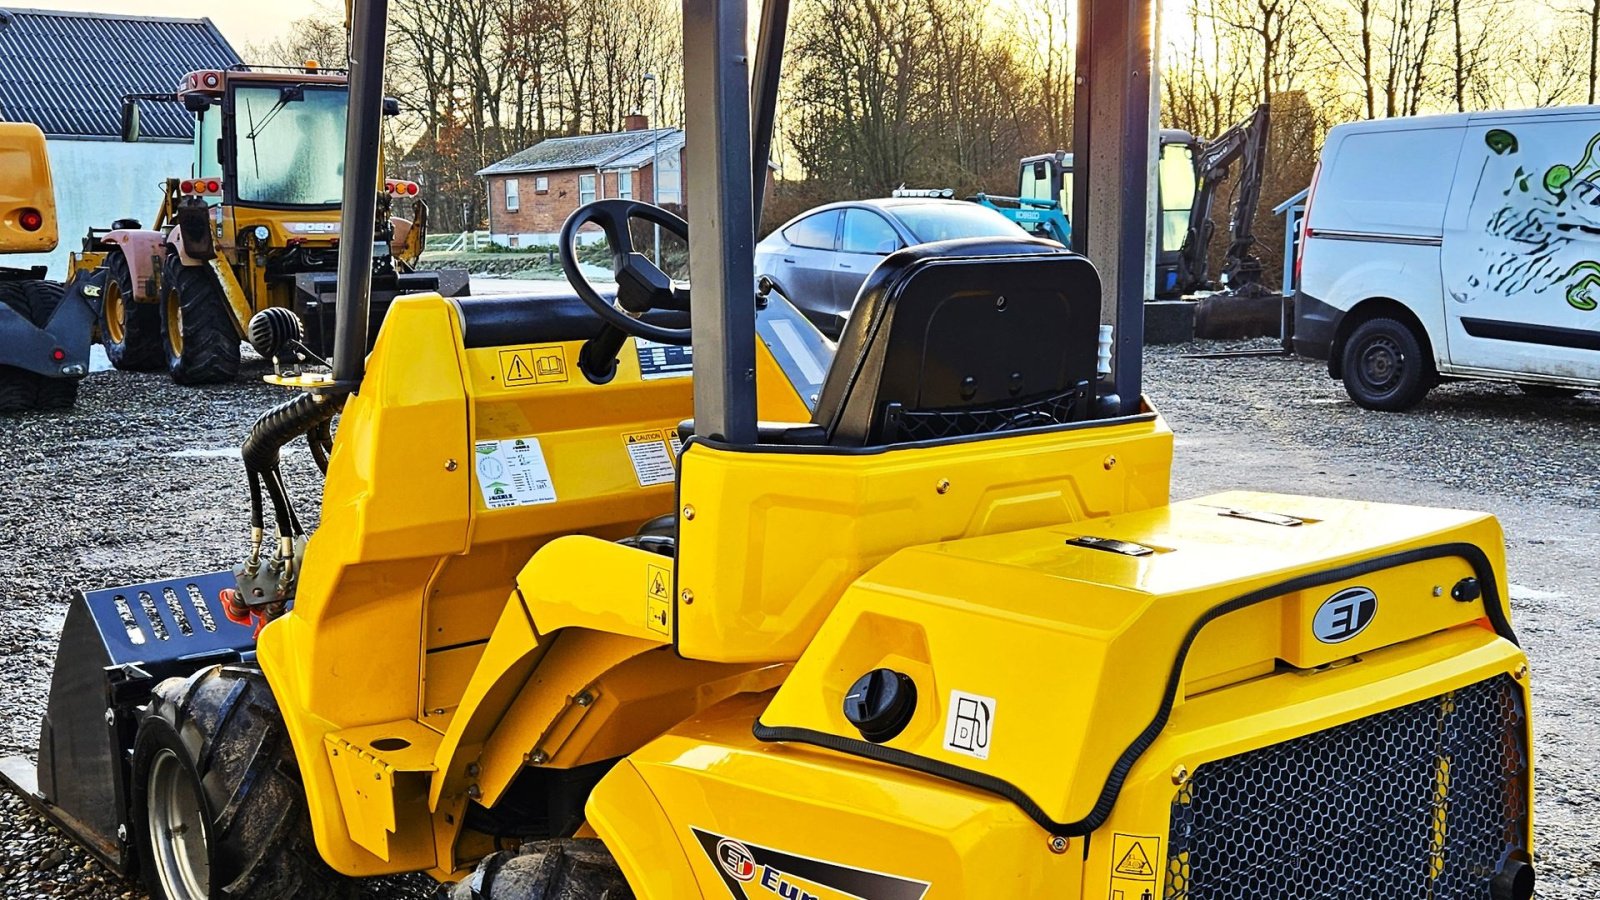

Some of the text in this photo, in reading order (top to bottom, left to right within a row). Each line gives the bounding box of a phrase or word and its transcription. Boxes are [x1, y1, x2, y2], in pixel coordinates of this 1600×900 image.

[635, 433, 661, 441] CAUTION
[1314, 590, 1376, 640] ET
[960, 727, 968, 739] D
